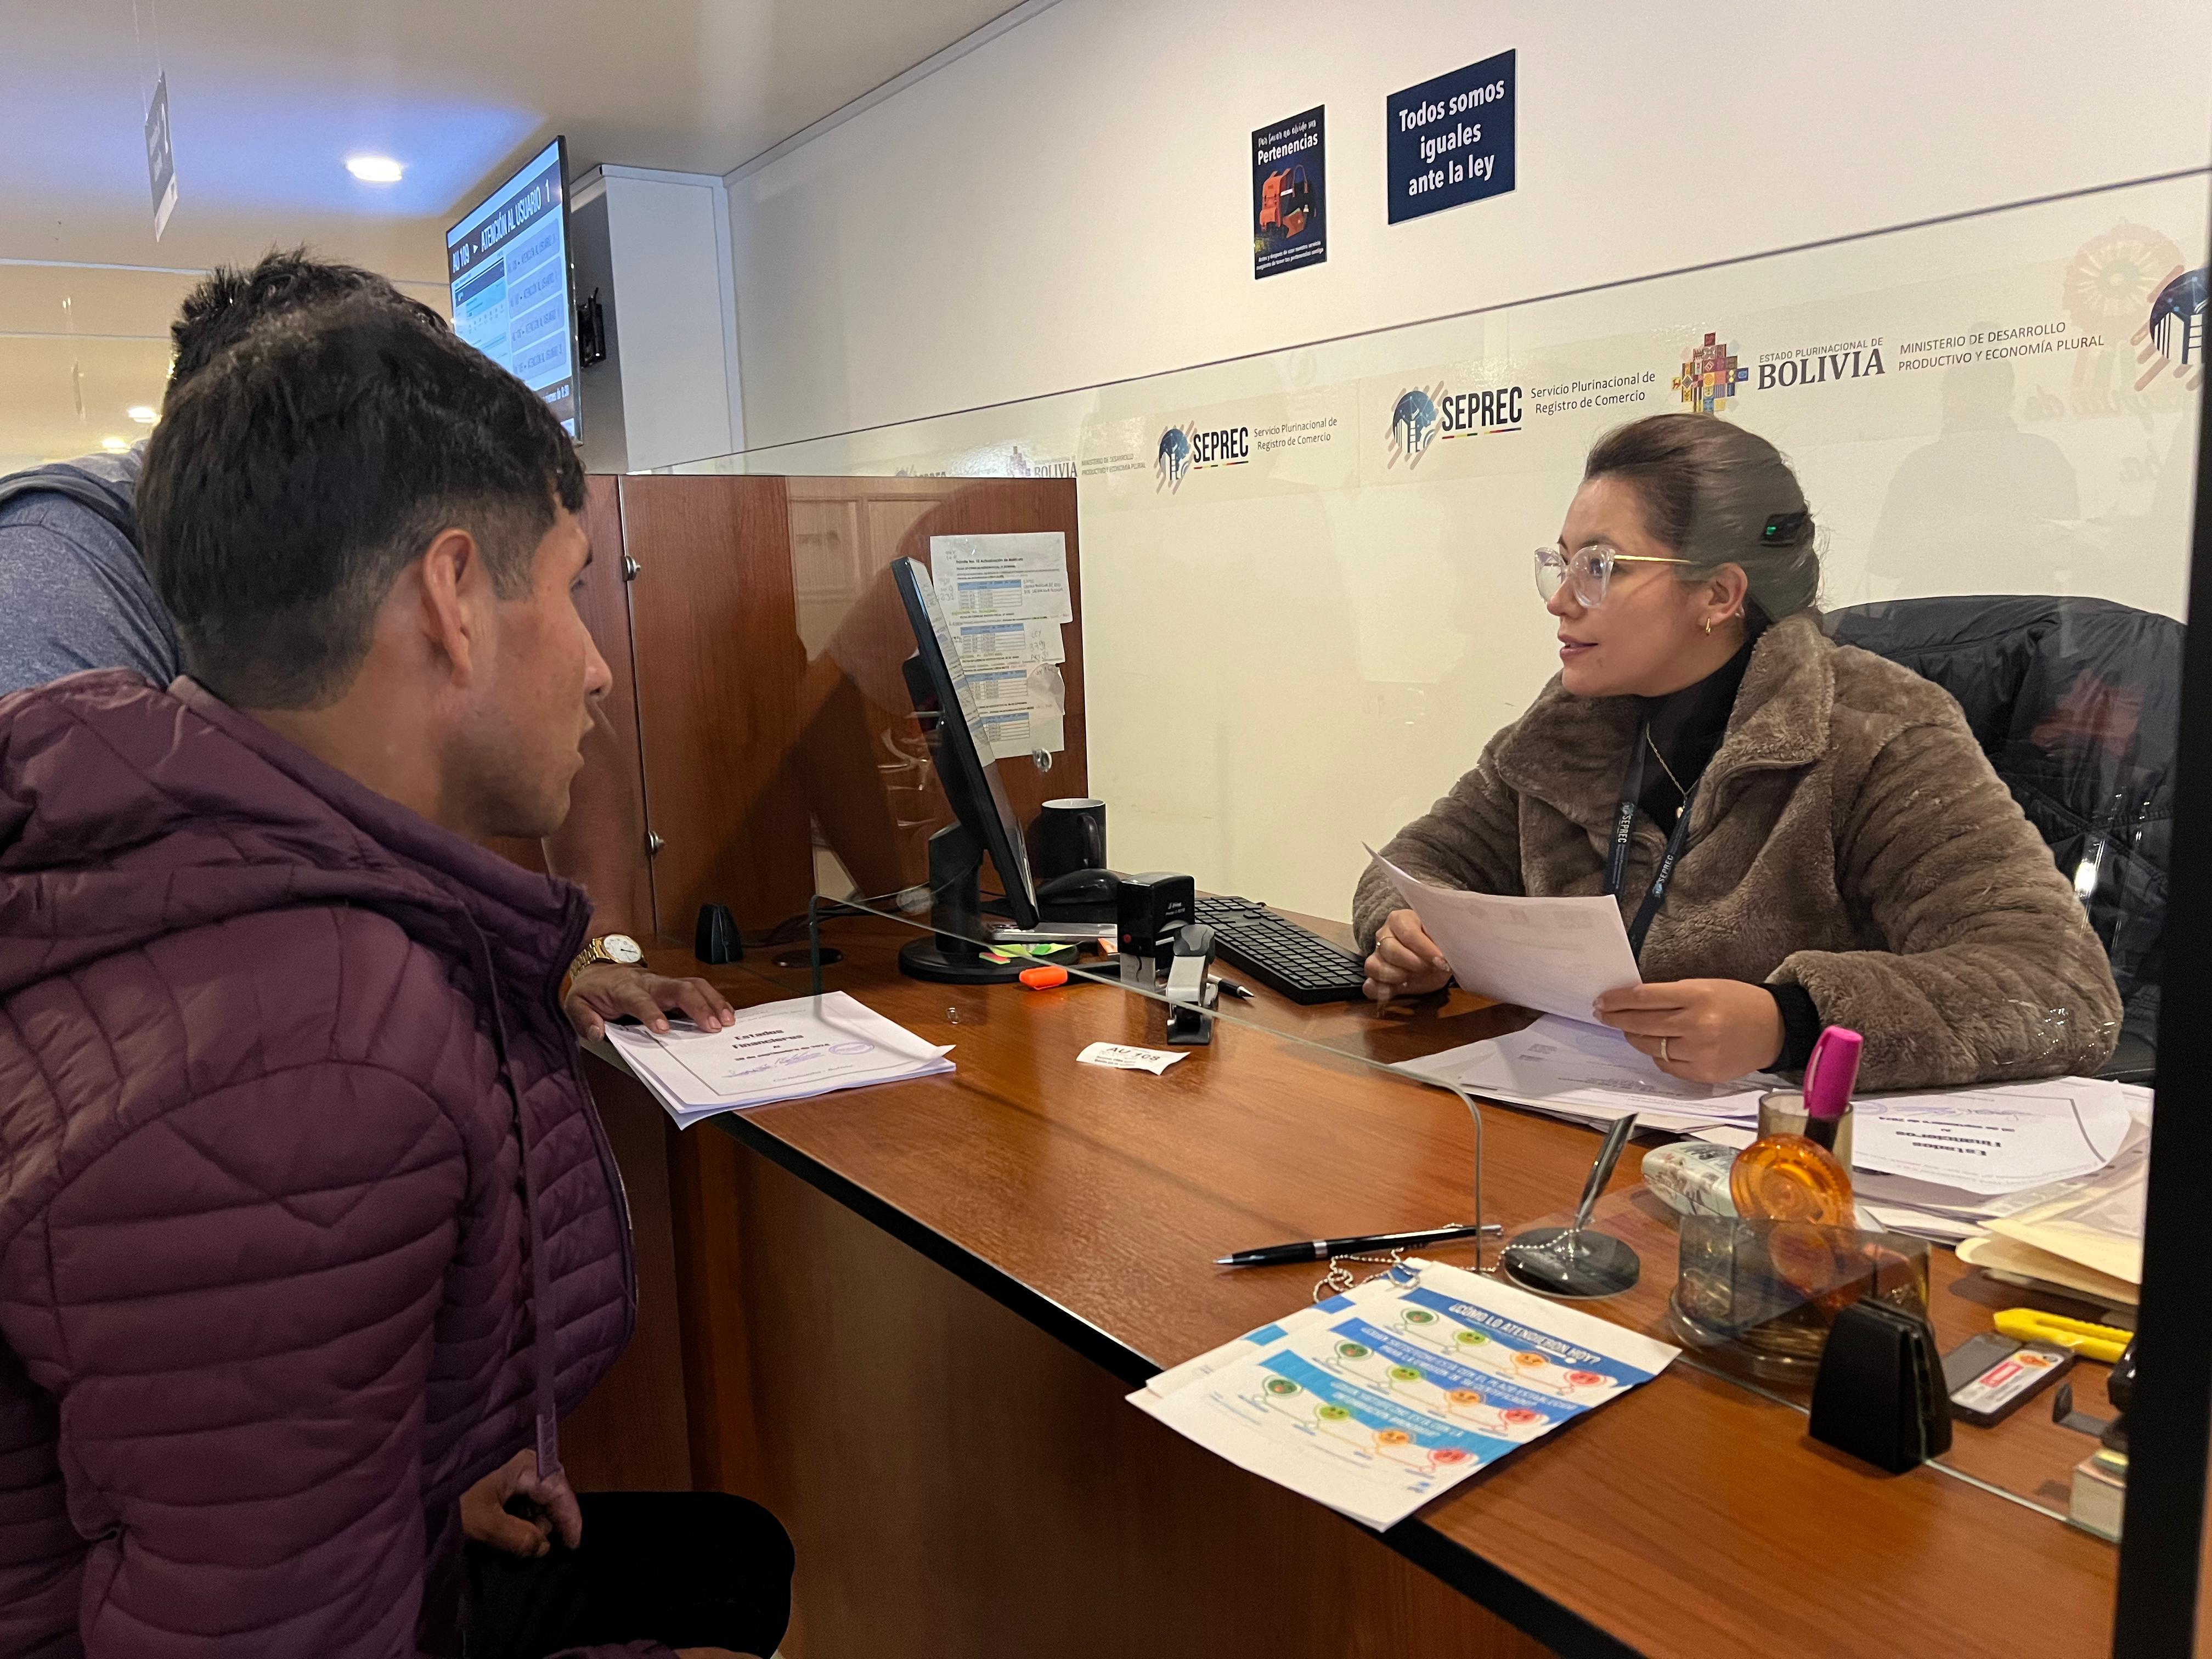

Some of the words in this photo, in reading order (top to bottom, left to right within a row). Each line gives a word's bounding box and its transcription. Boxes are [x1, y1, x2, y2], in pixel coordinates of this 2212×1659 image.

[1399, 101, 1445, 132] Todos
[1449, 80, 1505, 115] somos
[1258, 137, 1268, 148] Por
[1268, 133, 1282, 145] favor
[1283, 129, 1291, 138] no
[1258, 133, 1318, 165] Pertenencias
[1420, 122, 1481, 163] iguales
[1409, 170, 1444, 196] ante
[1449, 160, 1463, 184] la
[1469, 154, 1494, 181] ley
[453, 250, 460, 273] AU
[460, 243, 470, 267] 109
[481, 211, 507, 252] ATENCIÓN
[507, 208, 516, 233] AL
[515, 186, 541, 225] USUARIO
[545, 179, 550, 202] 1
[1759, 351, 1793, 363] ESTADO
[1796, 340, 1868, 358] PLURINACIONAL
[1871, 337, 1883, 347] DE
[1900, 336, 1965, 355] MINISTERIO
[1970, 333, 1984, 345] DE
[1988, 321, 2066, 342] DESARROLLO
[1899, 352, 1972, 371] PRODUCTIVO
[1976, 351, 1983, 361] Y
[1985, 340, 2053, 360] ECONOMÍA
[2057, 335, 2104, 351] PLURAL
[1758, 348, 1885, 390] BOLIVIA
[1531, 386, 1569, 398] Servicio
[1572, 373, 1639, 393] Plurinacional
[1643, 371, 1656, 383] de
[1442, 386, 1522, 431] SEPREC
[1536, 399, 1577, 416] Registro
[1580, 395, 1592, 408] de
[1595, 391, 1645, 406] Comercio
[1254, 425, 1280, 437] Servicio
[1282, 418, 1327, 433] Plurinacional
[1328, 416, 1338, 426] de
[1194, 427, 1248, 463] SEPREC
[1257, 439, 1286, 452] Registro
[1288, 436, 1296, 446] de
[1297, 432, 1331, 445] Comercio
[1035, 461, 1077, 478] BOLIVIA
[1618, 815, 1631, 844] SEPREC
[1657, 854, 1674, 883] SEPREC
[732, 1035, 804, 1049] Financieros
[734, 1029, 784, 1040] Estados
[1134, 1053, 1160, 1061] 108
[1895, 1131, 2001, 1147] Financieros
[1912, 1142, 1987, 1156] Estados
[1486, 1316, 1504, 1328] LO
